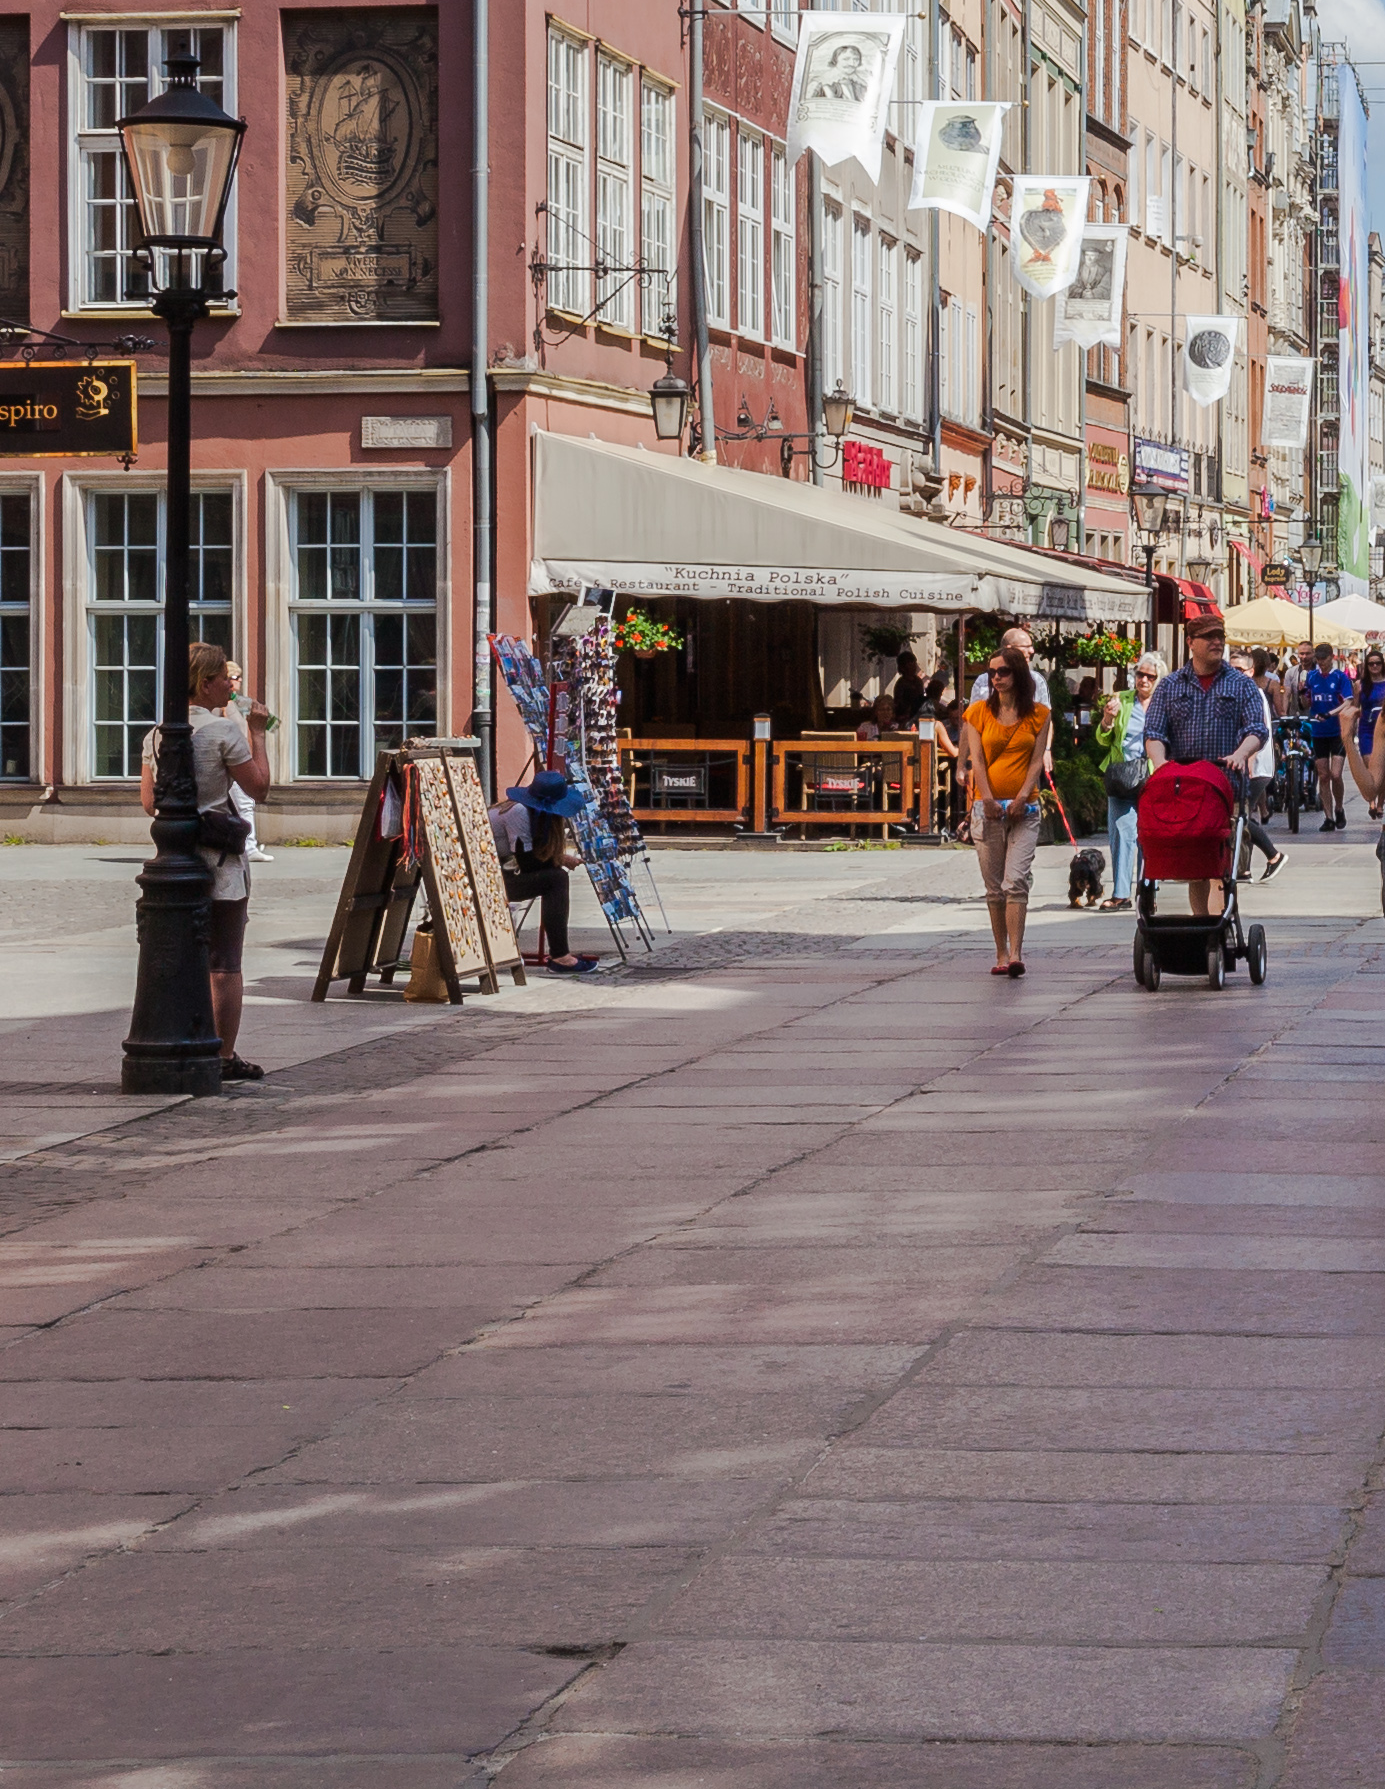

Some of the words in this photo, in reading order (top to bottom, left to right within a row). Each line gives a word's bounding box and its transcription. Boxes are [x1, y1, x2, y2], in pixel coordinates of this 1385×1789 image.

[549, 577, 582, 589] Café
[610, 579, 700, 591] Restaurant
[728, 584, 825, 597] Traditional
[836, 588, 890, 599] Polish
[900, 589, 963, 602] Cuisine
[662, 775, 697, 788] TYSKIE
[827, 777, 860, 790] TYSKIE
